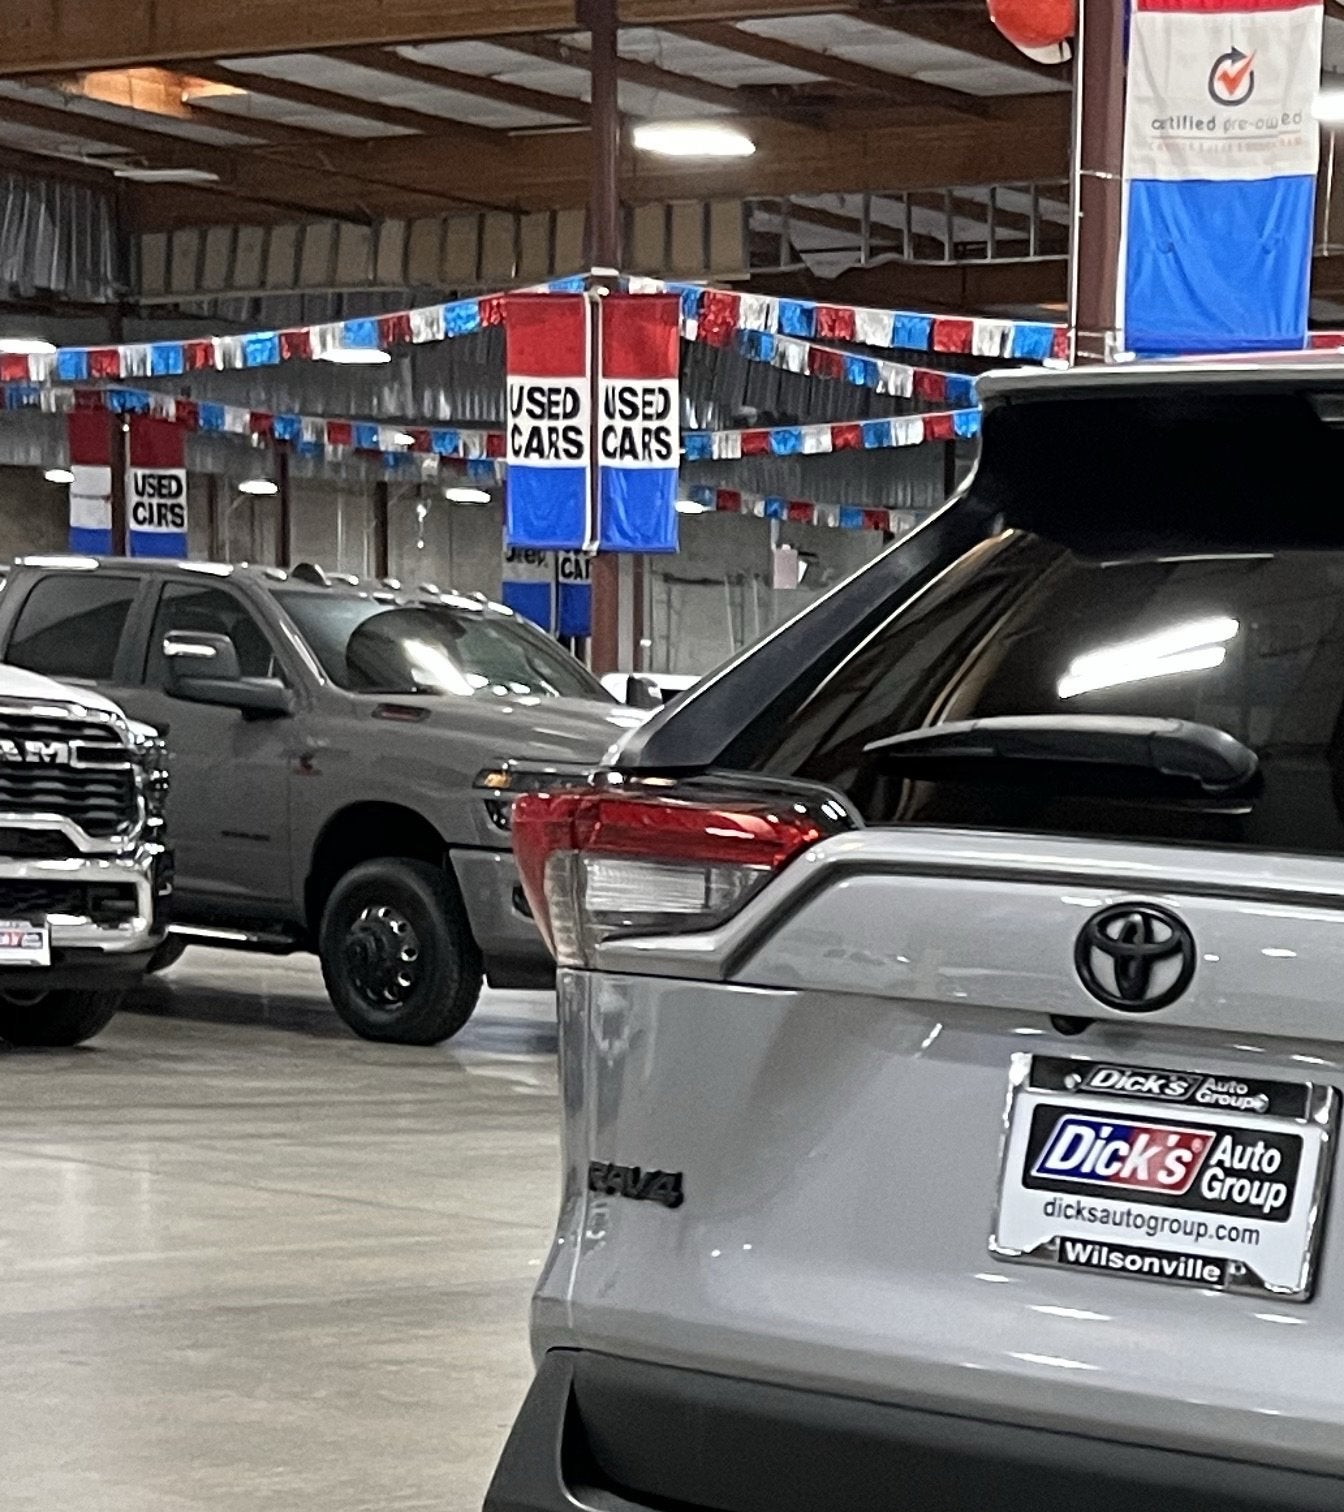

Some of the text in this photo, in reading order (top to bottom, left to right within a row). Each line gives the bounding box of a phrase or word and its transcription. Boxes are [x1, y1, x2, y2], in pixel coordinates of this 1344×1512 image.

[1151, 115, 1216, 131] cetified
[510, 384, 581, 421] USED
[604, 385, 672, 421] USED
[511, 422, 585, 460] CARS
[602, 424, 672, 461] CARS
[133, 472, 183, 498] USED
[1090, 1069, 1189, 1097] Dick's
[1195, 1089, 1257, 1111] Group
[1202, 1077, 1248, 1095] Auto
[1045, 1124, 1193, 1185] Dick's
[1209, 1135, 1282, 1175] Auto
[1201, 1167, 1288, 1213] Group
[1042, 1197, 1261, 1245] dicksautogroup.com
[1064, 1241, 1222, 1282] Wilsonville
